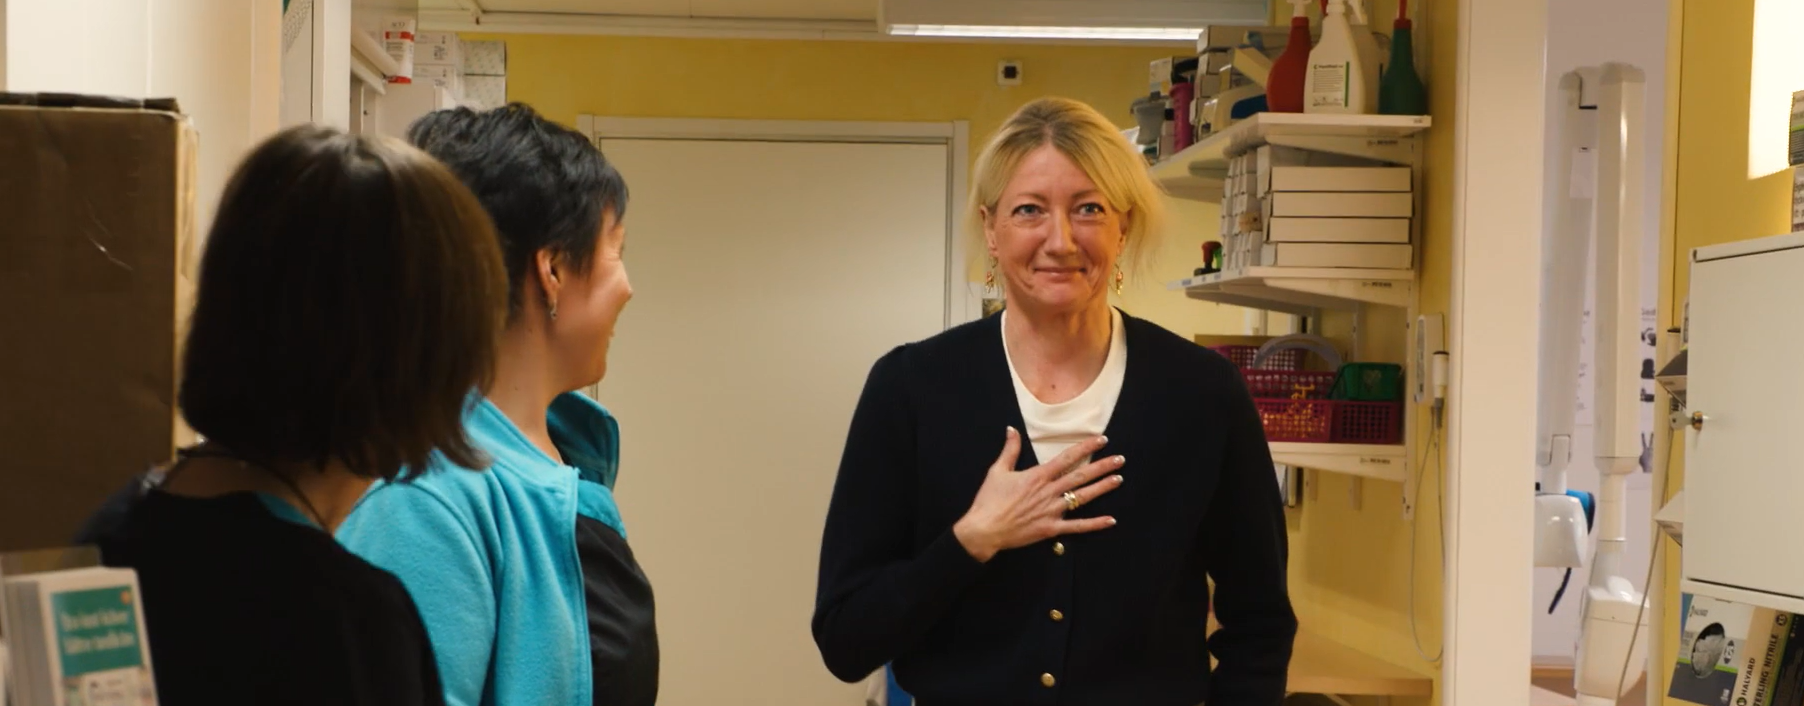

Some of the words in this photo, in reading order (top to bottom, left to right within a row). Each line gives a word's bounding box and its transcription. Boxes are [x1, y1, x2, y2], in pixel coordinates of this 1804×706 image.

[1741, 657, 1756, 696] HALYARD
[1753, 670, 1769, 706] TERLING
[1764, 633, 1779, 669] NITRILE
